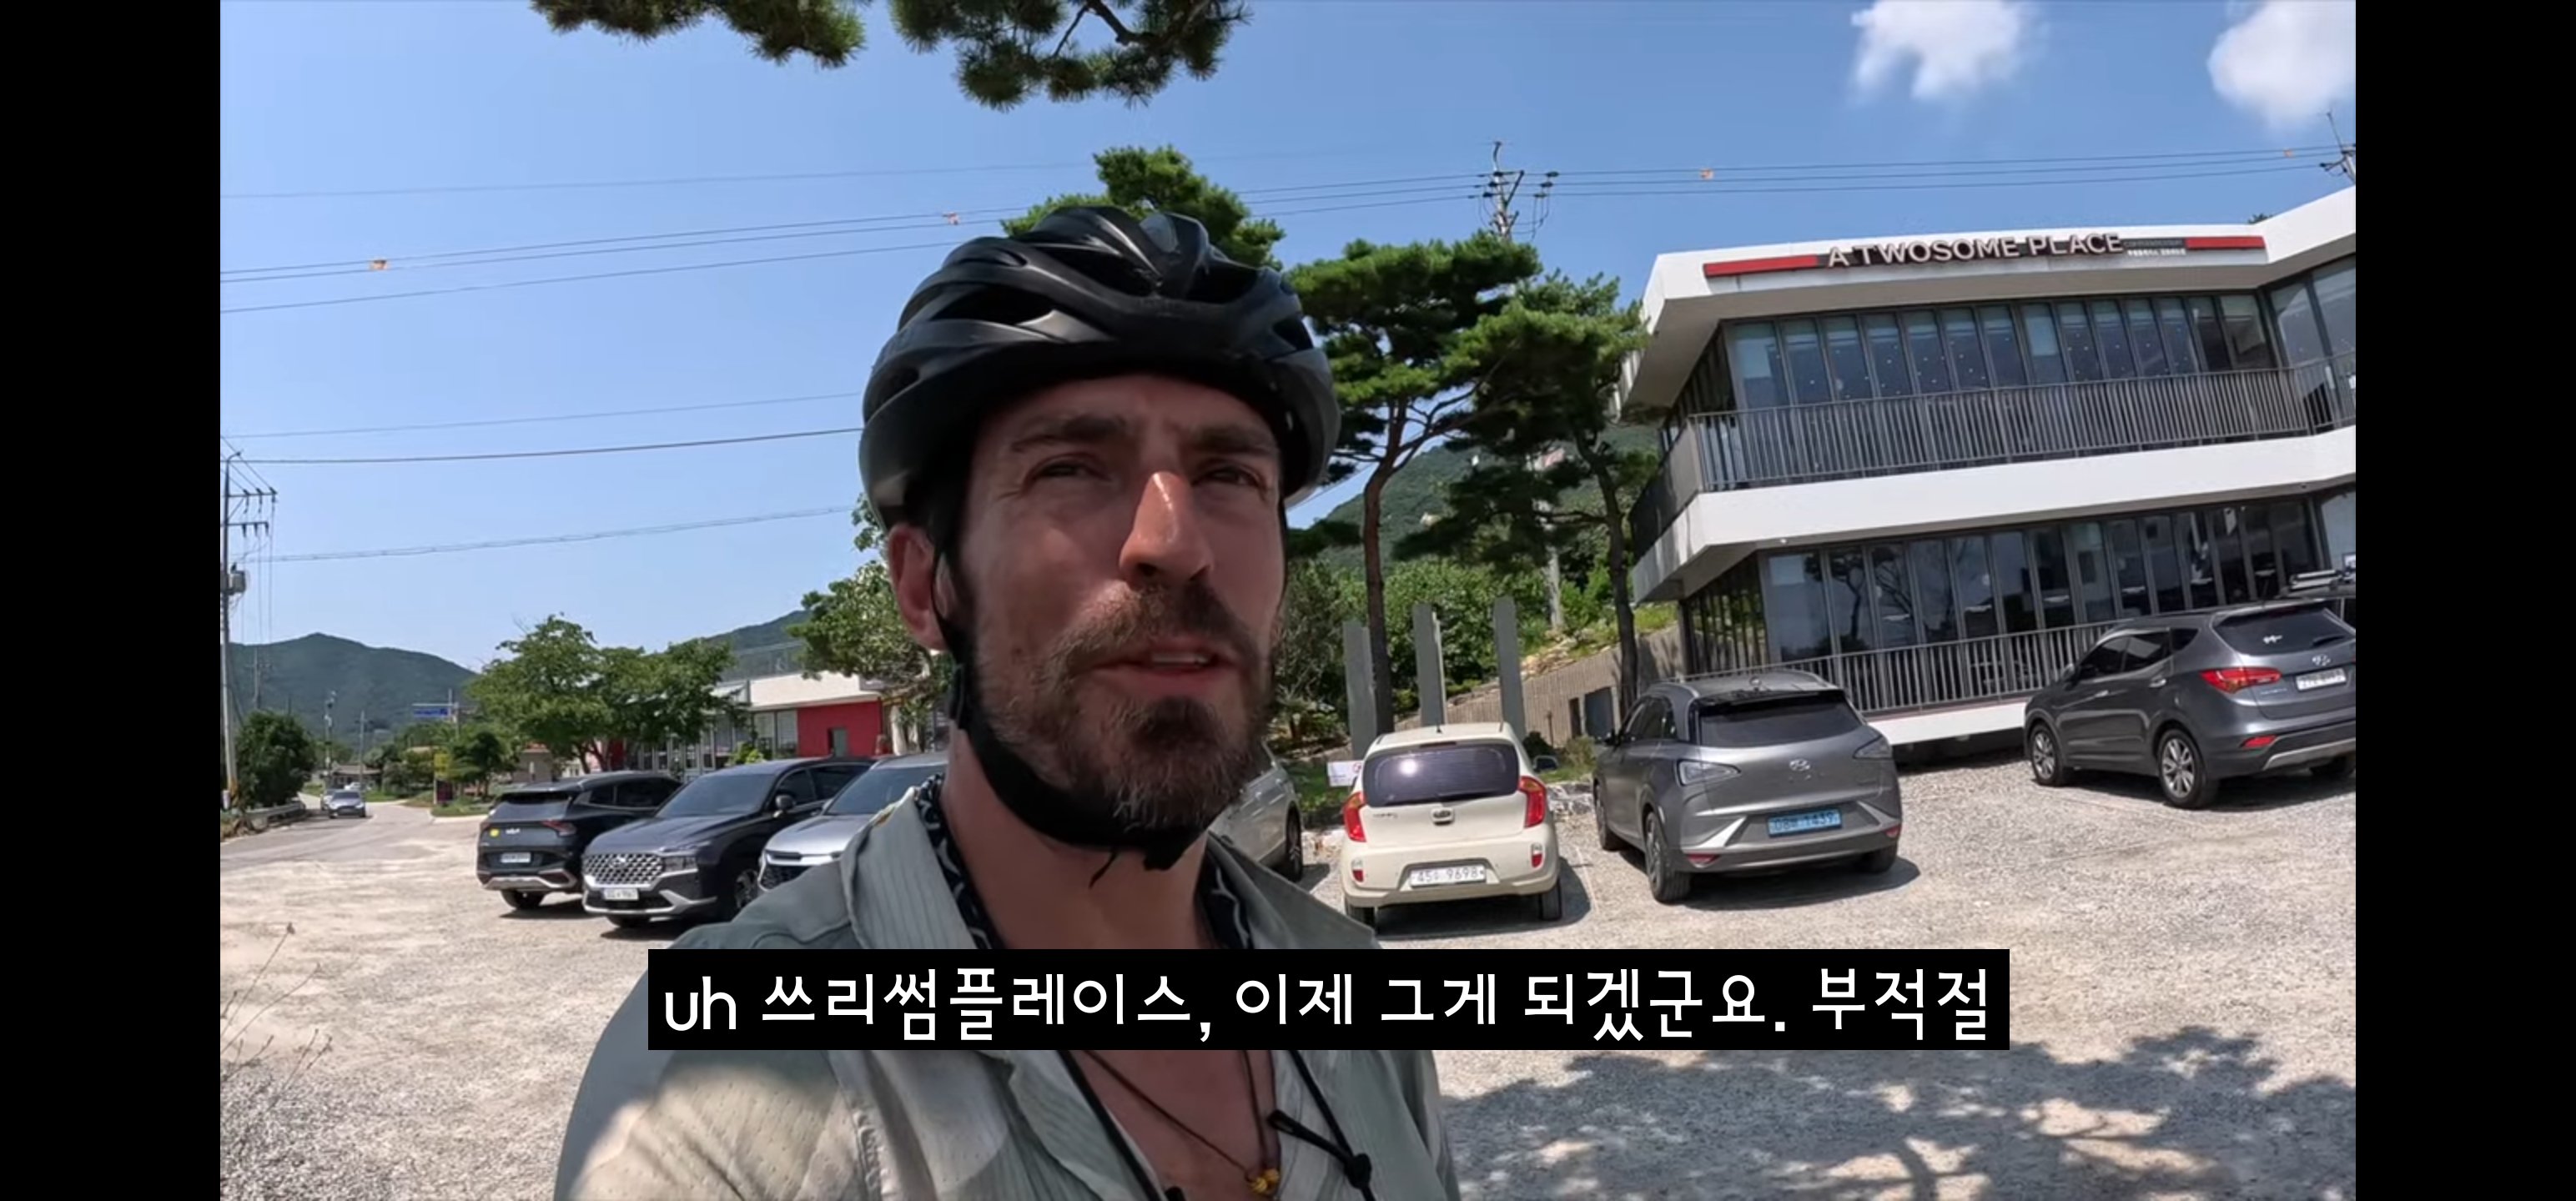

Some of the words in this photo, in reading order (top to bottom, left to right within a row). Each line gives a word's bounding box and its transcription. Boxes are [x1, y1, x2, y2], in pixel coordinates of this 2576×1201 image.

[1828, 246, 1850, 267] A
[1853, 237, 2020, 266] TWOSOME
[2027, 233, 2124, 255] PLACE
